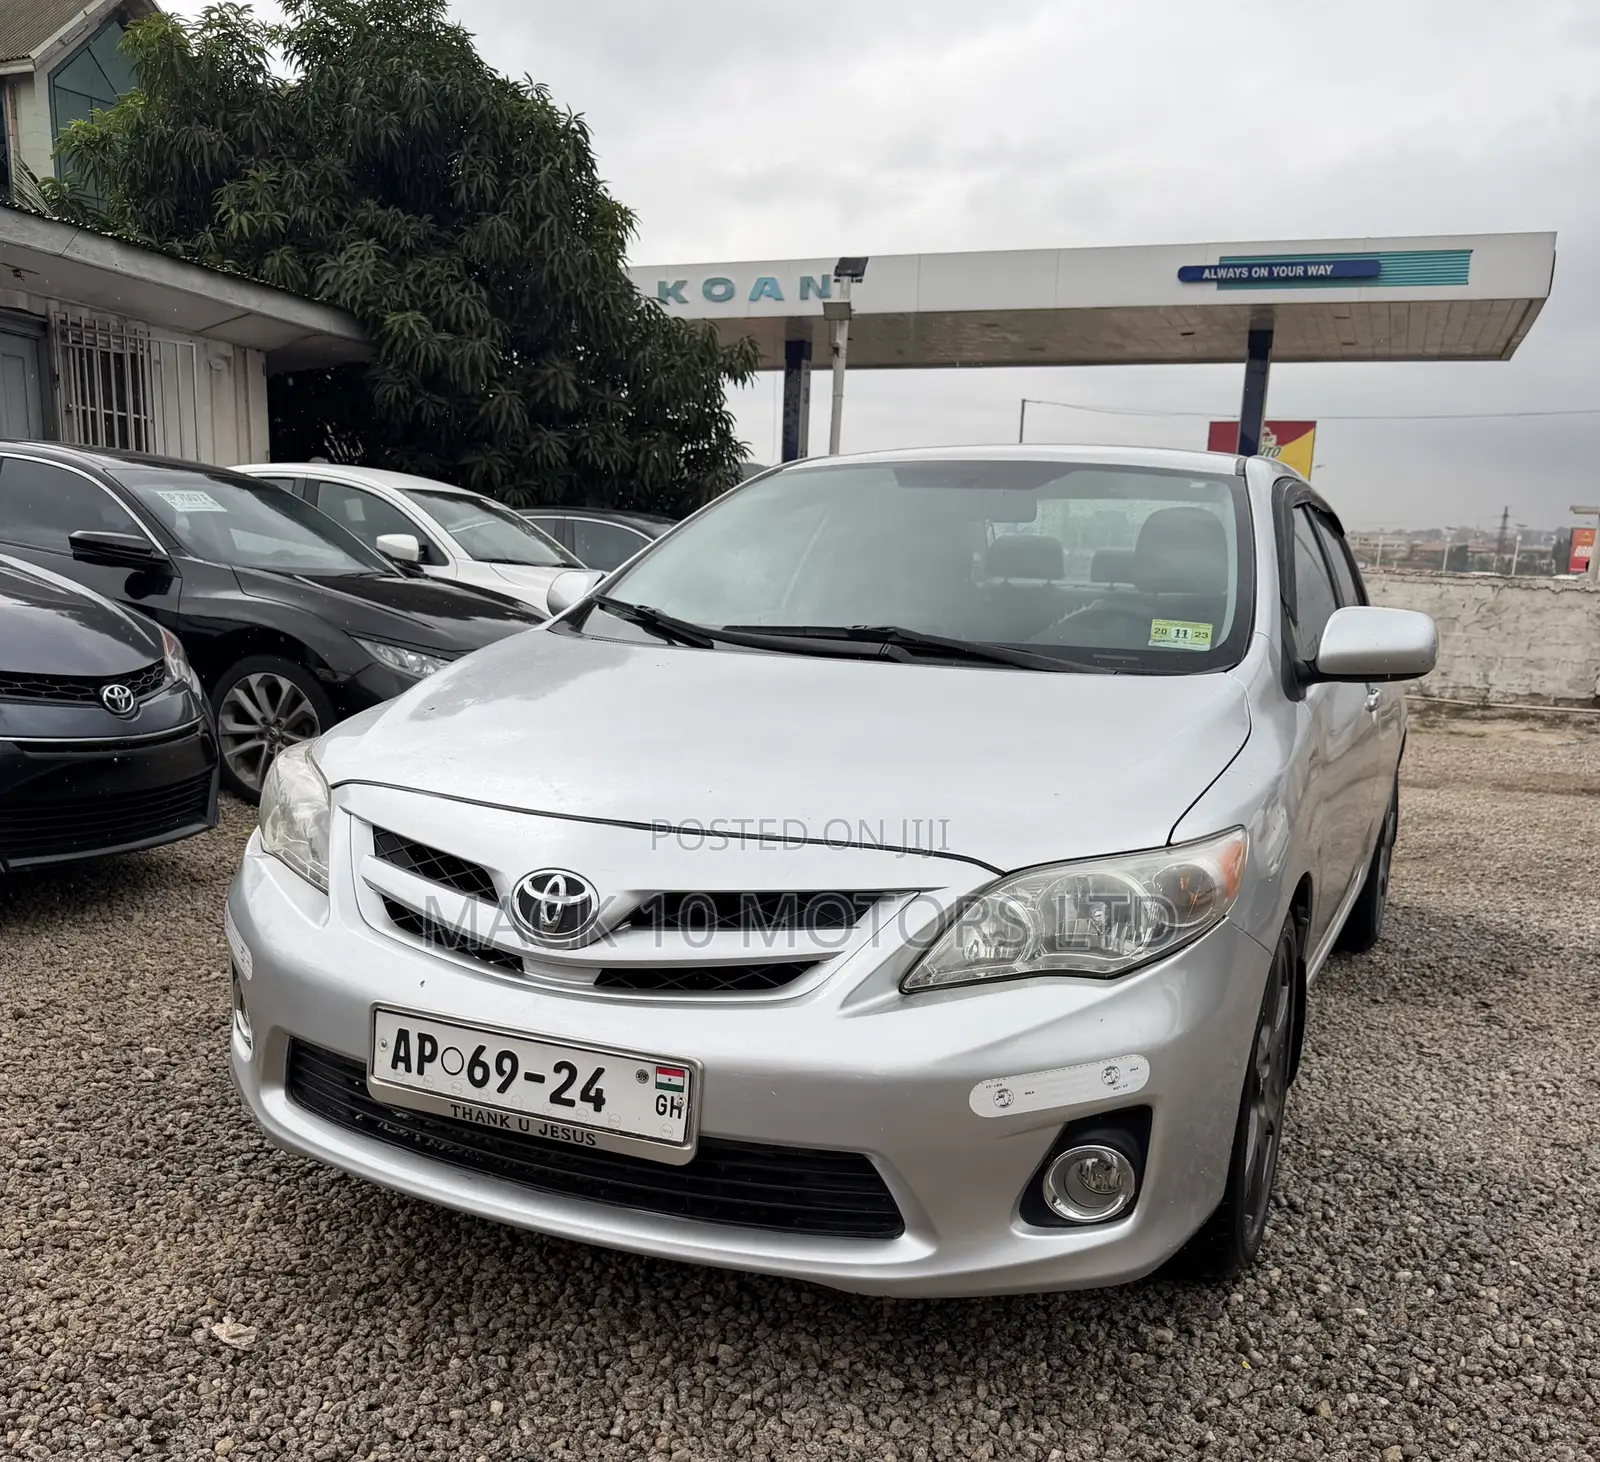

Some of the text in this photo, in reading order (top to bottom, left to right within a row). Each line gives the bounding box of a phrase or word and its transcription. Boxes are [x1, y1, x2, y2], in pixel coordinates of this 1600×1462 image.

[1202, 264, 1334, 280] ALWAYS ON YOUR WAY
[1154, 627, 1209, 639] 20 11 23
[390, 1028, 438, 1076] AP
[655, 1094, 683, 1119] GH
[450, 1104, 597, 1147] THANK U JESUS
